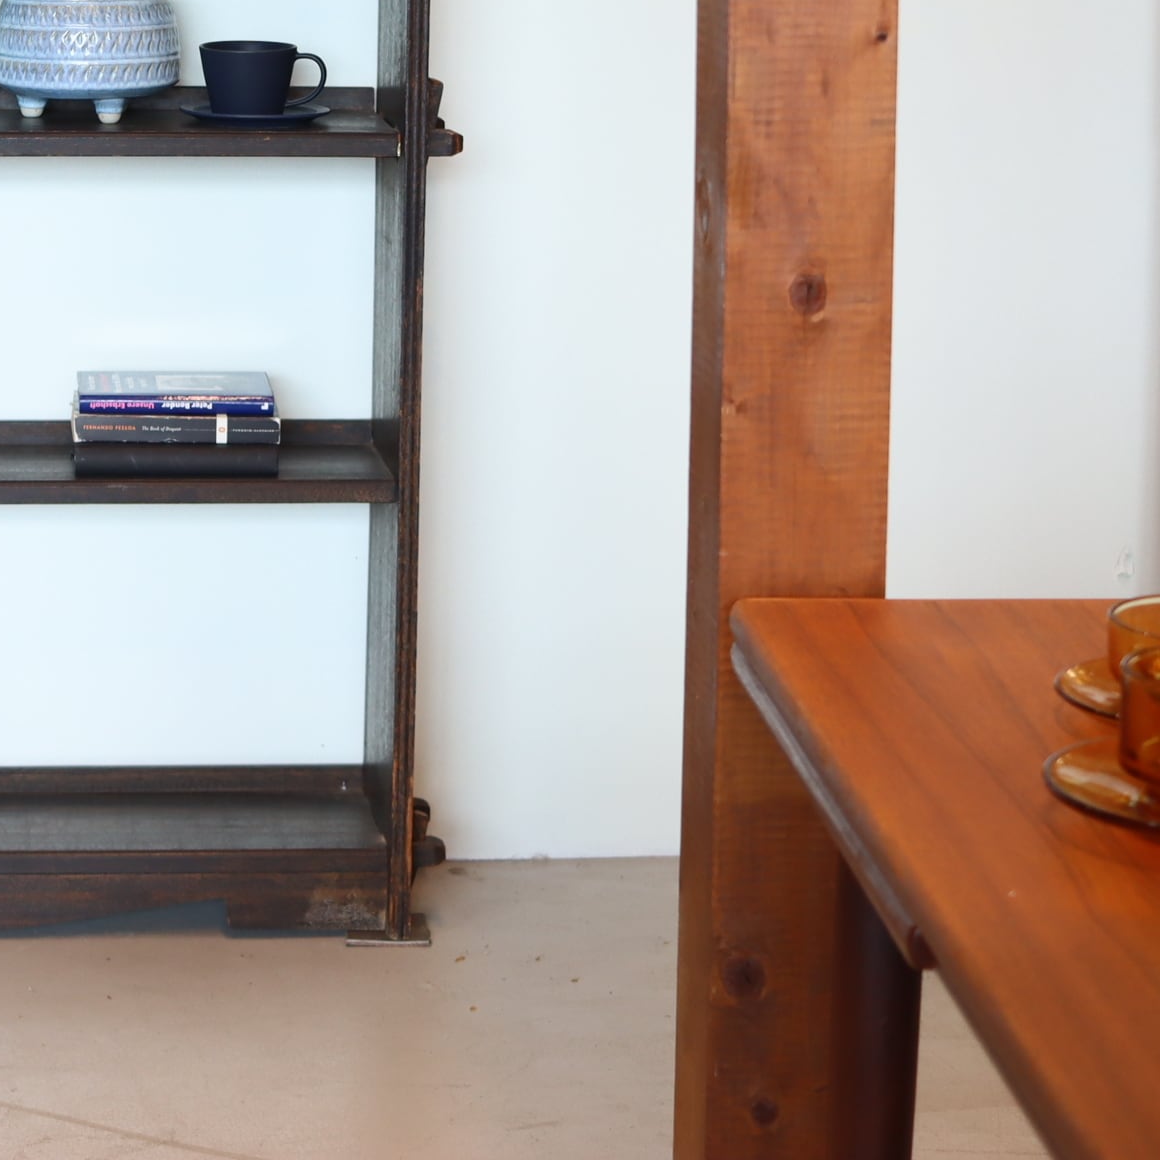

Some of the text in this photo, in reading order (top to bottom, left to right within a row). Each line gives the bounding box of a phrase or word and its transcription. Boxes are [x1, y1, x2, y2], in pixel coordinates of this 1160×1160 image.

[127, 401, 155, 409] Unsere
[161, 401, 213, 410] Peter Bender
